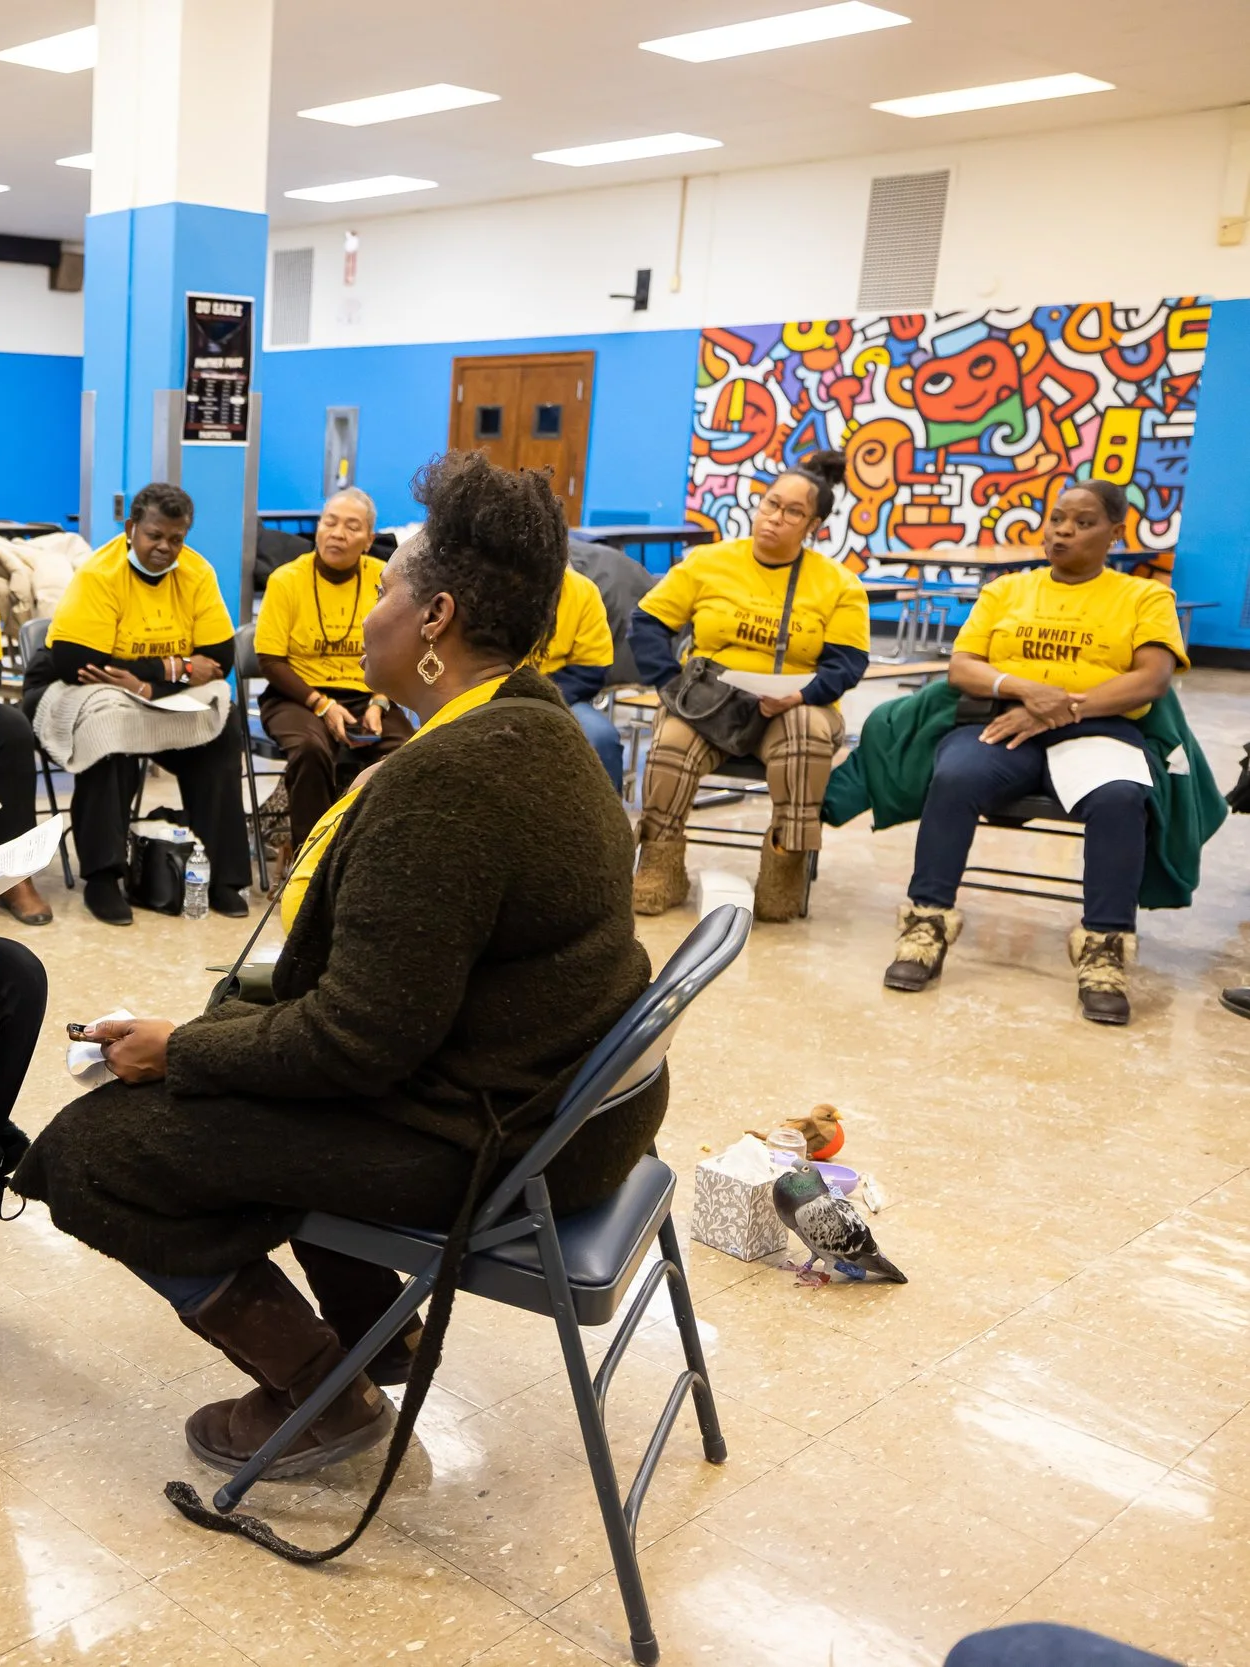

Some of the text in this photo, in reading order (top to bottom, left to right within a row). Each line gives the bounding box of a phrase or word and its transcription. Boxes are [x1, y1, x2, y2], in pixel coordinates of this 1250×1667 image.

[733, 609, 802, 633] DO WHA IS
[1015, 625, 1033, 638] DO
[1038, 627, 1077, 643] WHAT
[1080, 632, 1094, 646] IS
[131, 638, 187, 655] DO WHAT IS
[331, 640, 360, 653] WHAT
[1022, 639, 1082, 663] RIGHT
